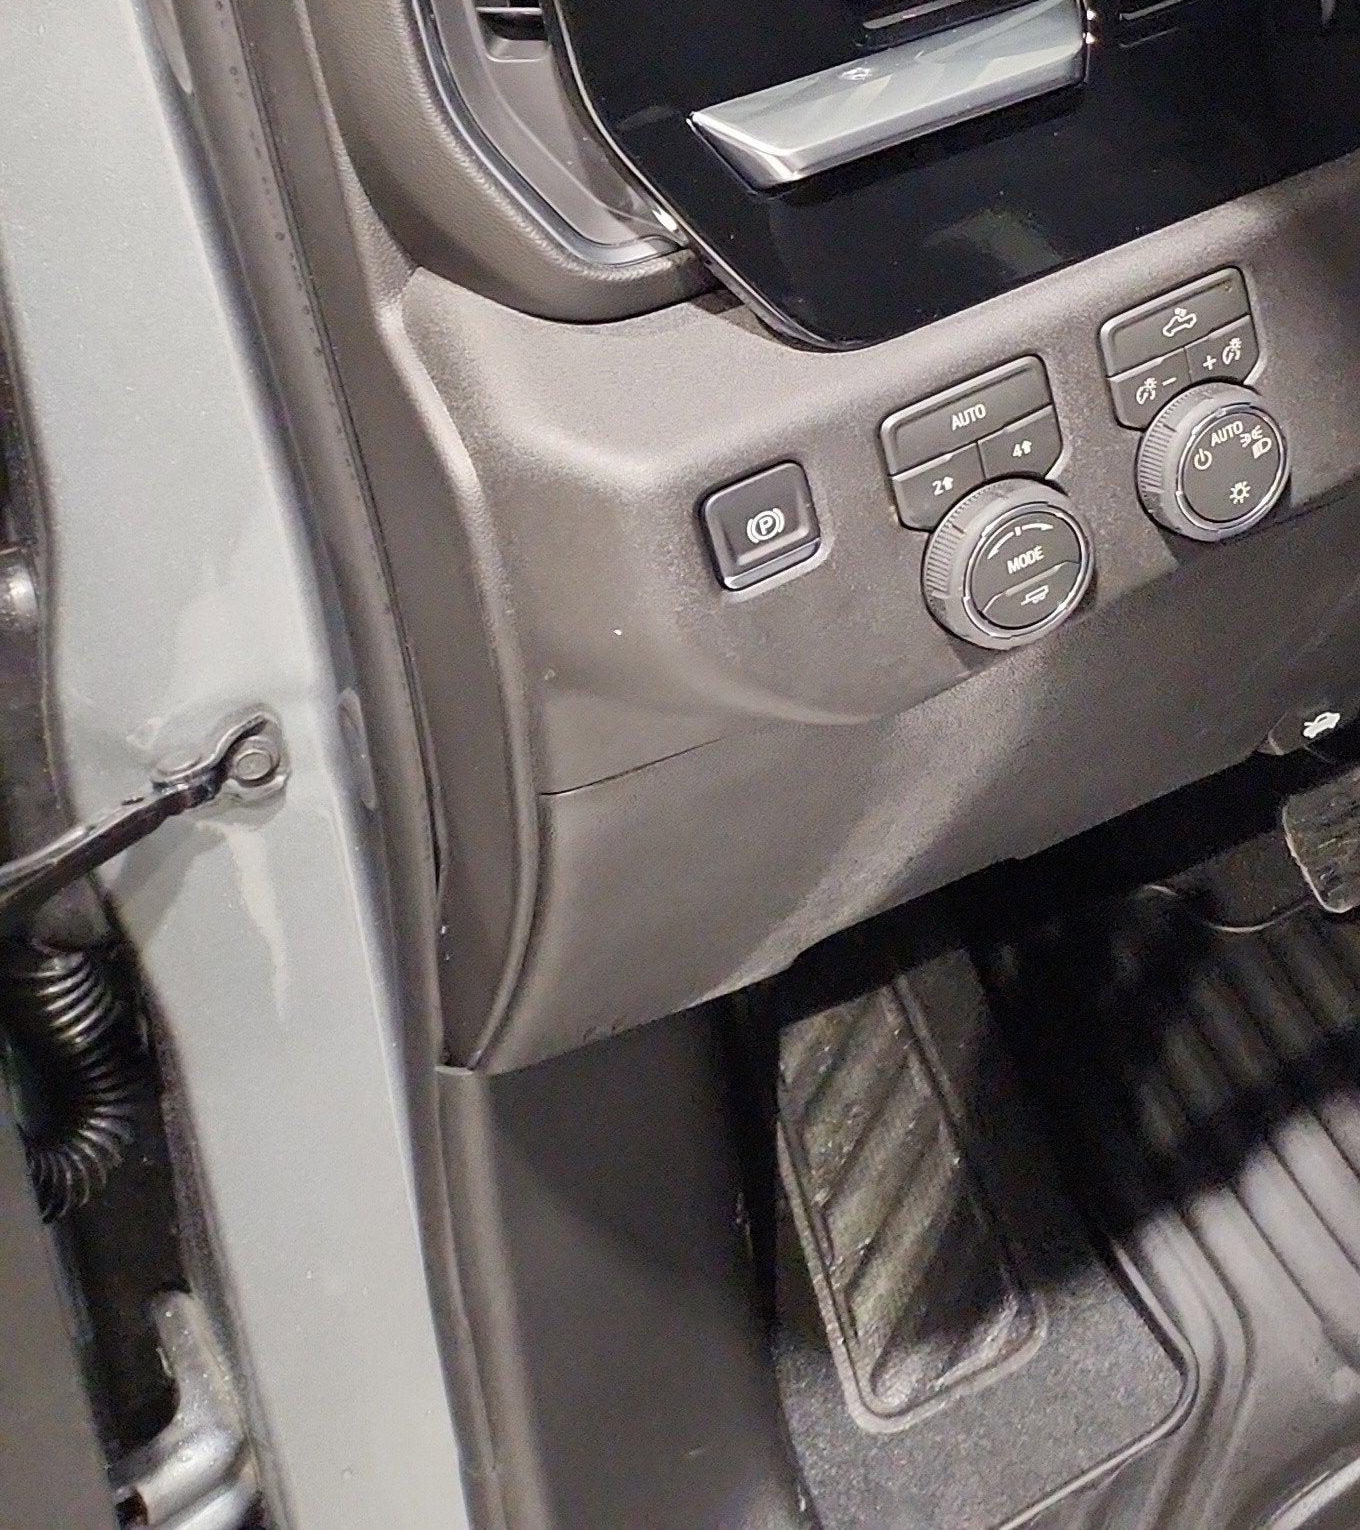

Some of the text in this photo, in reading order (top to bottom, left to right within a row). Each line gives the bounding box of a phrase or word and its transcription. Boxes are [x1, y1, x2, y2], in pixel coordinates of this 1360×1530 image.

[951, 403, 987, 431] AUTO
[1209, 419, 1244, 450] AUTO
[1006, 545, 1045, 575] MODE
